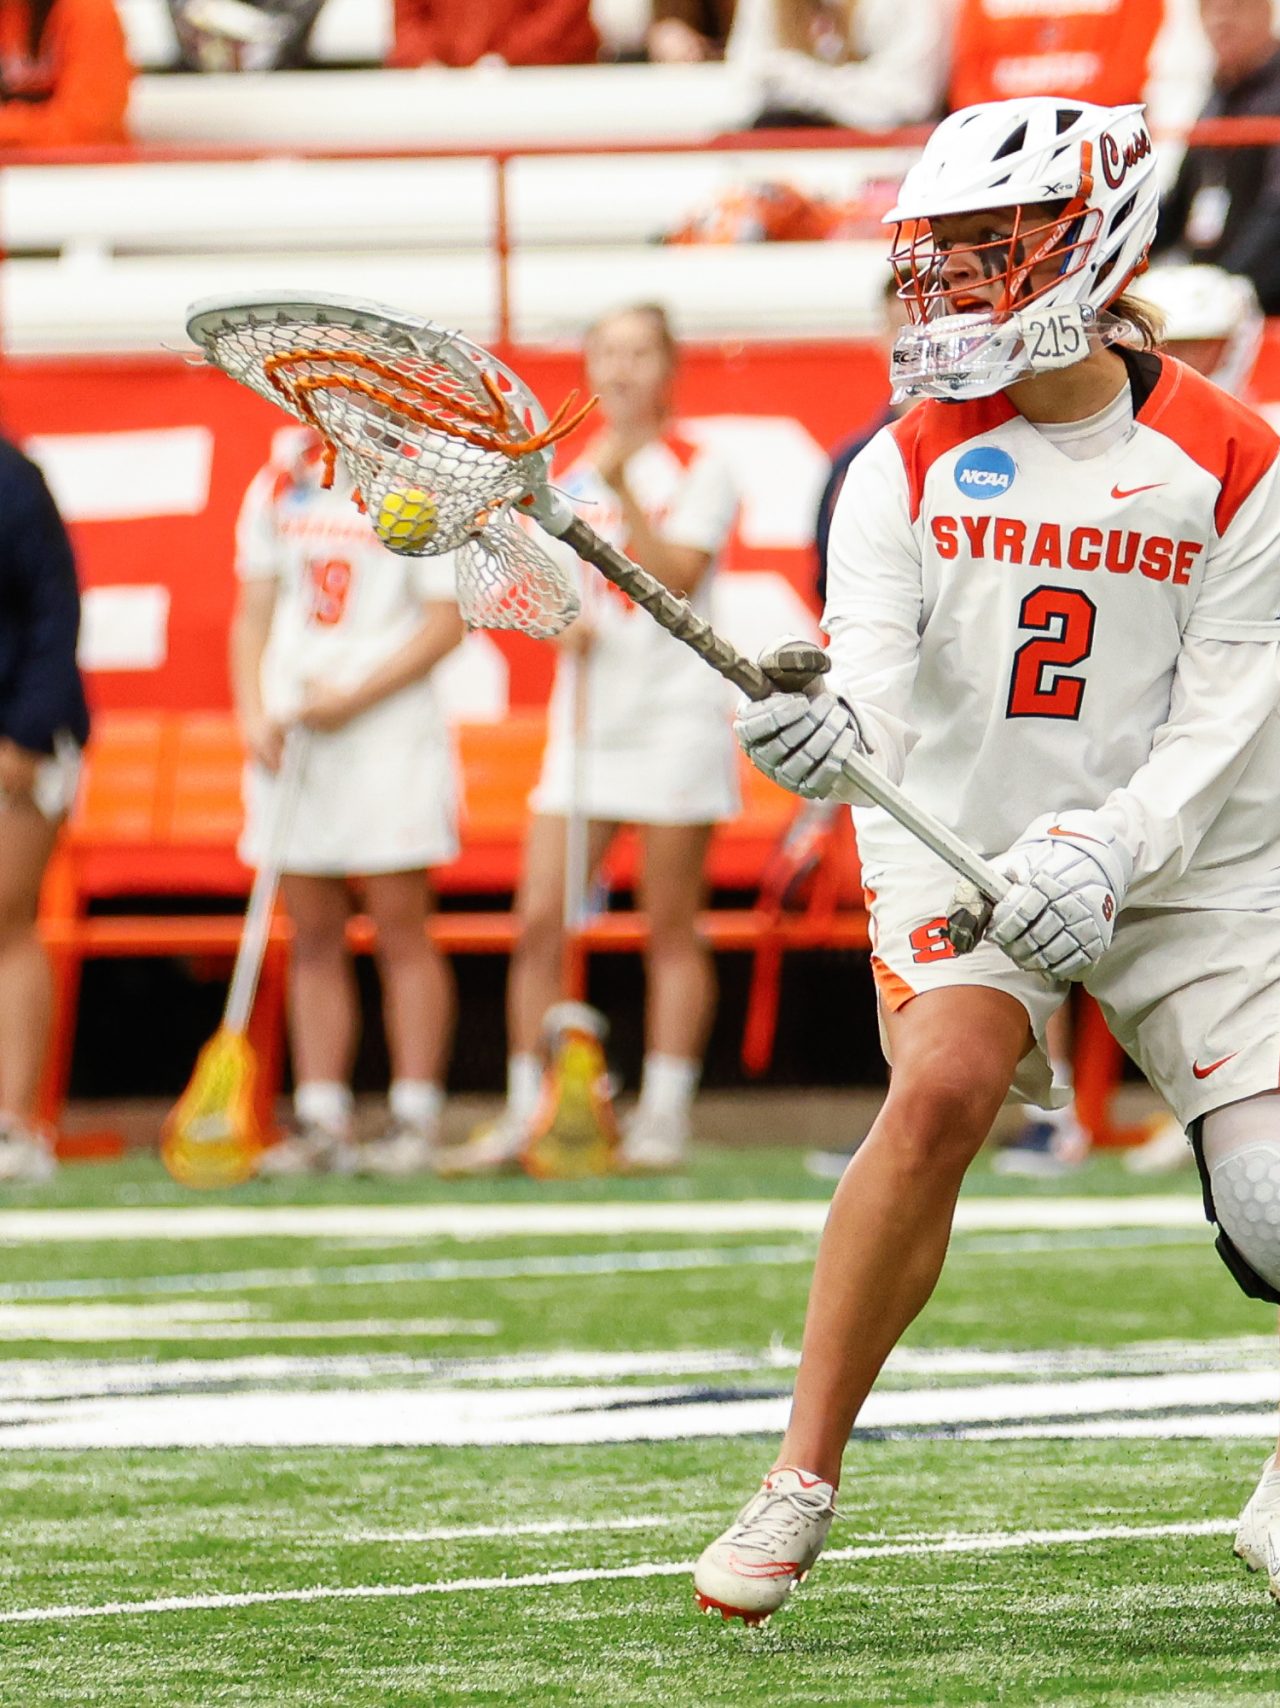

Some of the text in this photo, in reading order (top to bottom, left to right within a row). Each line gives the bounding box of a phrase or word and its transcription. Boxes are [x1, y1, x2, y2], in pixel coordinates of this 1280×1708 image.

[1029, 314, 1079, 360] 215
[959, 468, 1010, 488] NCAA
[930, 514, 1204, 586] SYRACUSE
[1005, 584, 1098, 721] 2
